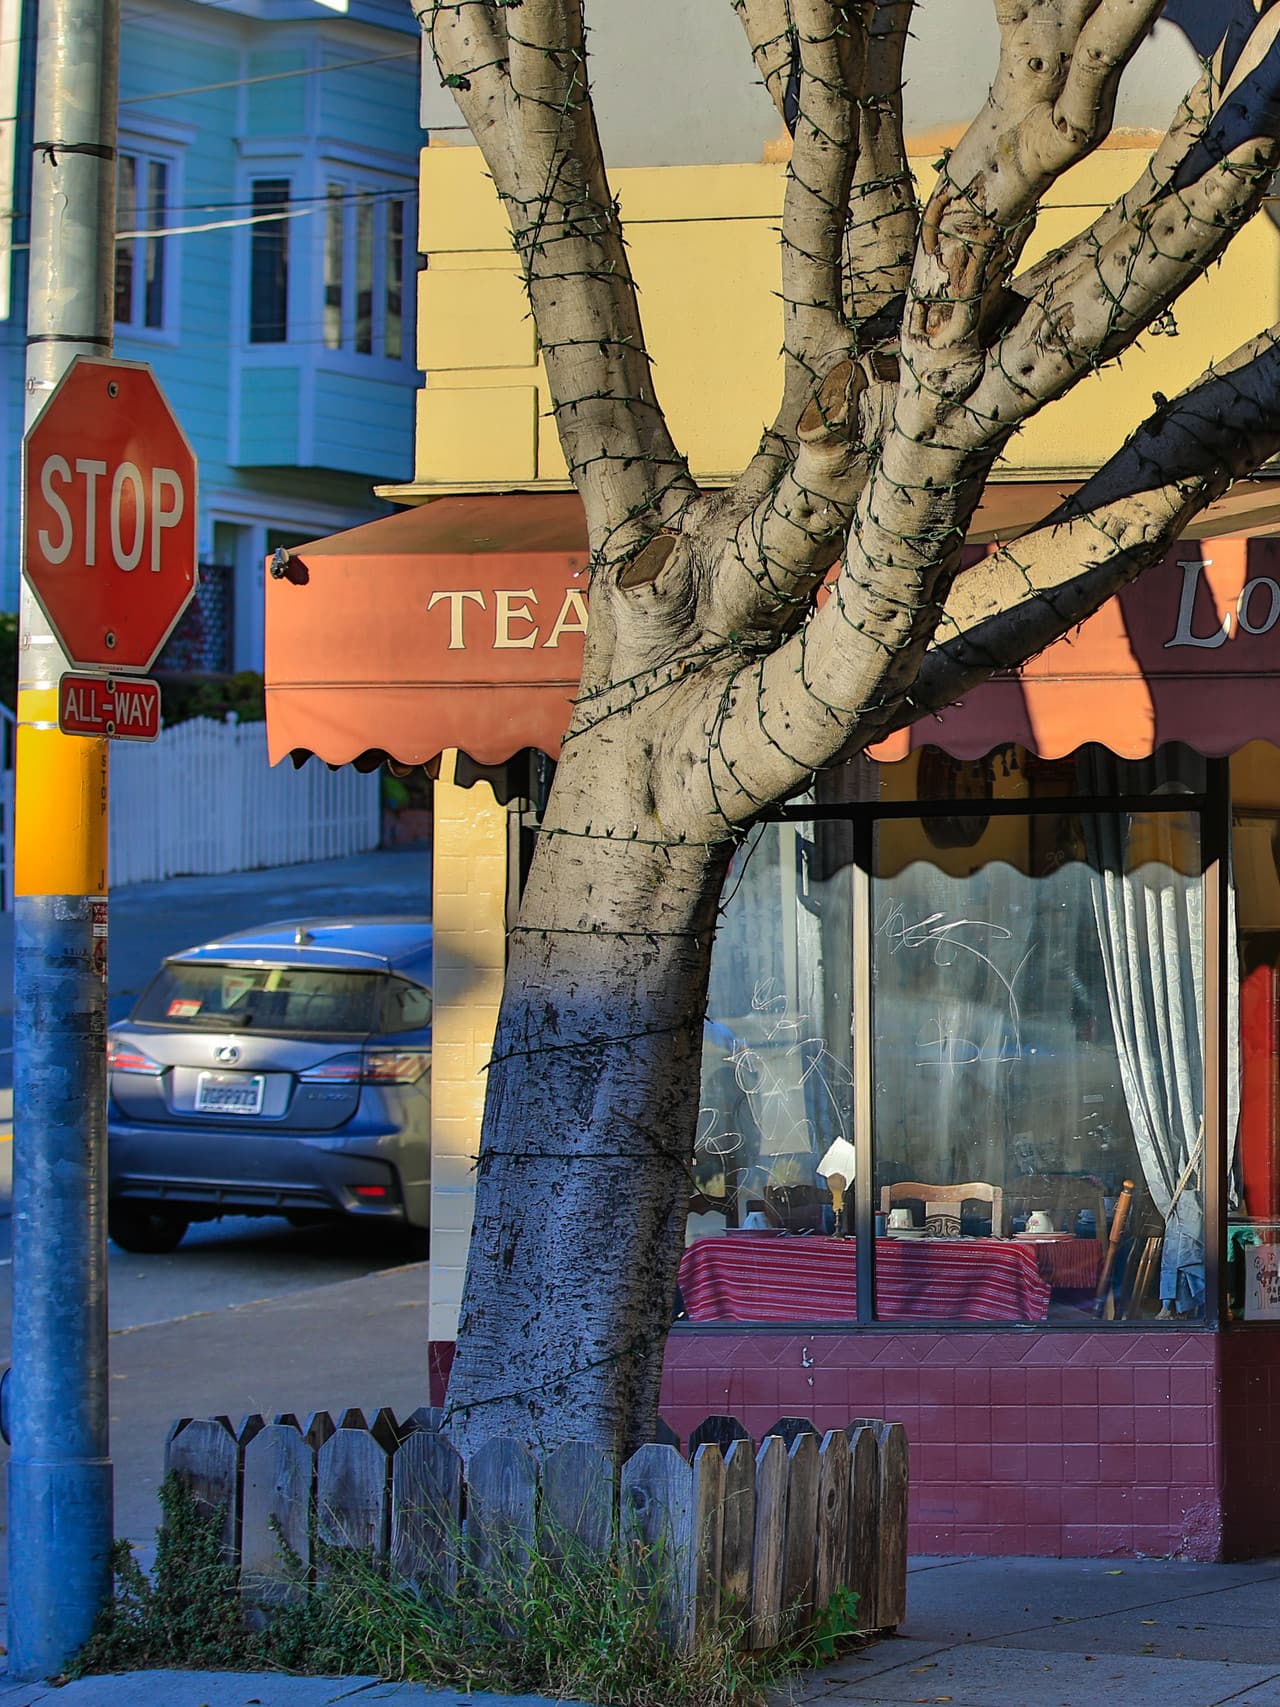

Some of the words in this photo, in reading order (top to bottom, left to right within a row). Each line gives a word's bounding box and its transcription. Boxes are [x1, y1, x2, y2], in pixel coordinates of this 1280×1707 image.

[38, 454, 184, 573] STOP
[427, 588, 589, 650] TEA
[64, 688, 155, 727] ALL-WAY
